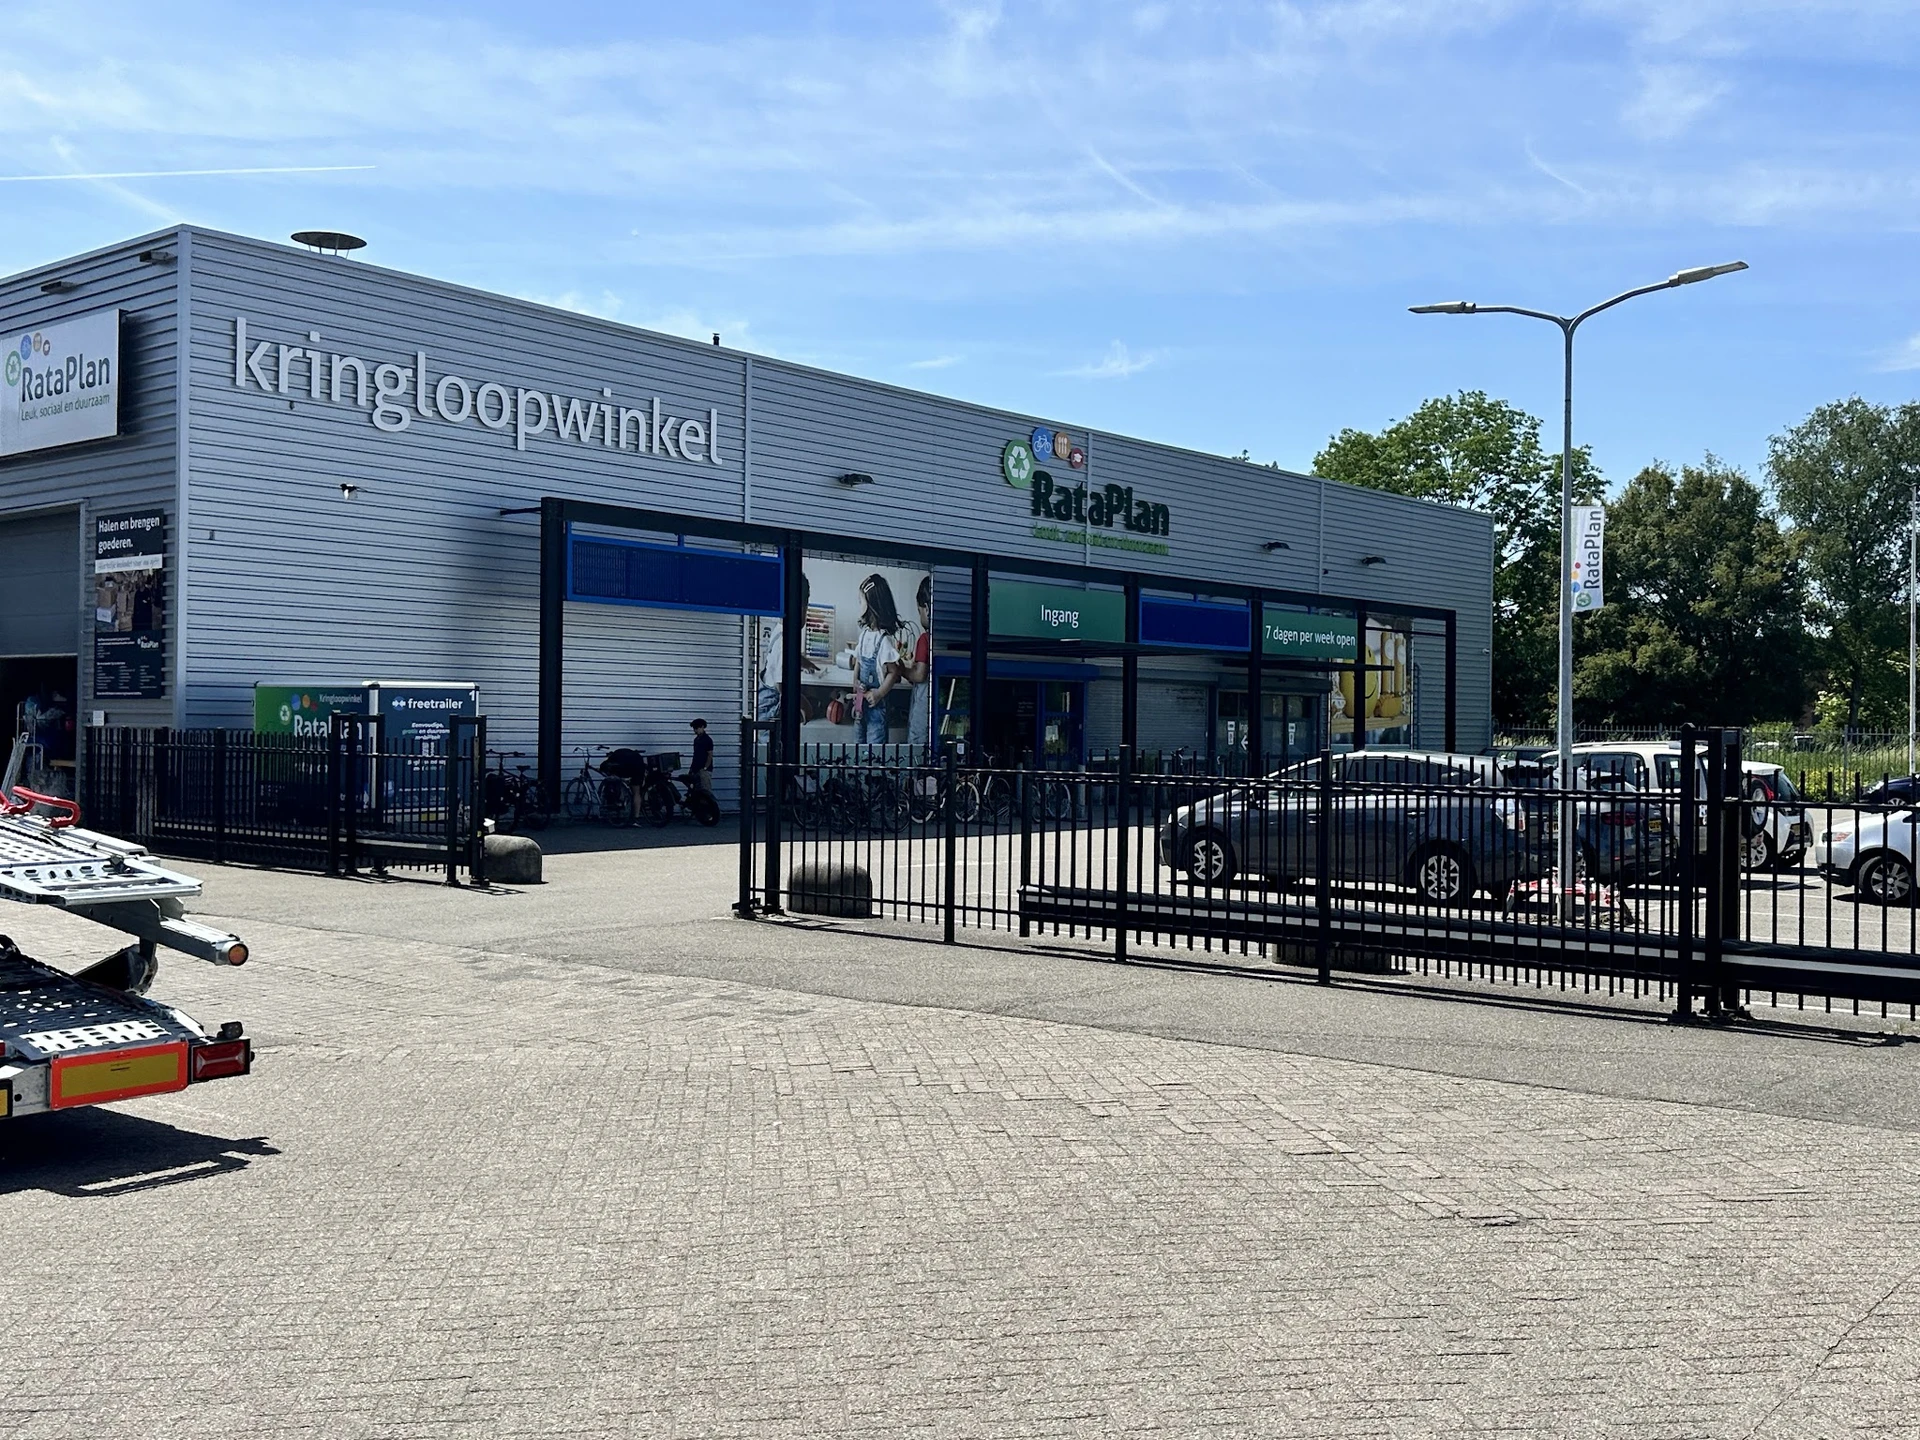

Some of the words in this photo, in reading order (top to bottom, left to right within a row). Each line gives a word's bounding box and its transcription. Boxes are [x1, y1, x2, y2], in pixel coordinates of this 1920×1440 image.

[22, 353, 110, 402] RataPlan
[235, 317, 722, 465] kringloopwinkel
[40, 402, 63, 417] sociaal
[64, 401, 73, 412] en
[75, 394, 110, 411] duurzaam
[1030, 470, 1170, 536] RataPlan
[98, 519, 119, 533] Halen
[120, 520, 129, 530] en
[130, 516, 160, 531] brengen
[98, 537, 133, 554] goederen.
[1583, 510, 1602, 589] RataPlan
[1041, 604, 1079, 628] Ingang
[1265, 625, 1272, 639] 7
[1273, 626, 1298, 645] dagen
[1300, 631, 1313, 646] per
[1314, 631, 1335, 645] week
[1336, 634, 1356, 649] open
[319, 694, 363, 705] Kringloopwinkel
[408, 699, 463, 709] freetrailer
[468, 690, 475, 701] 1
